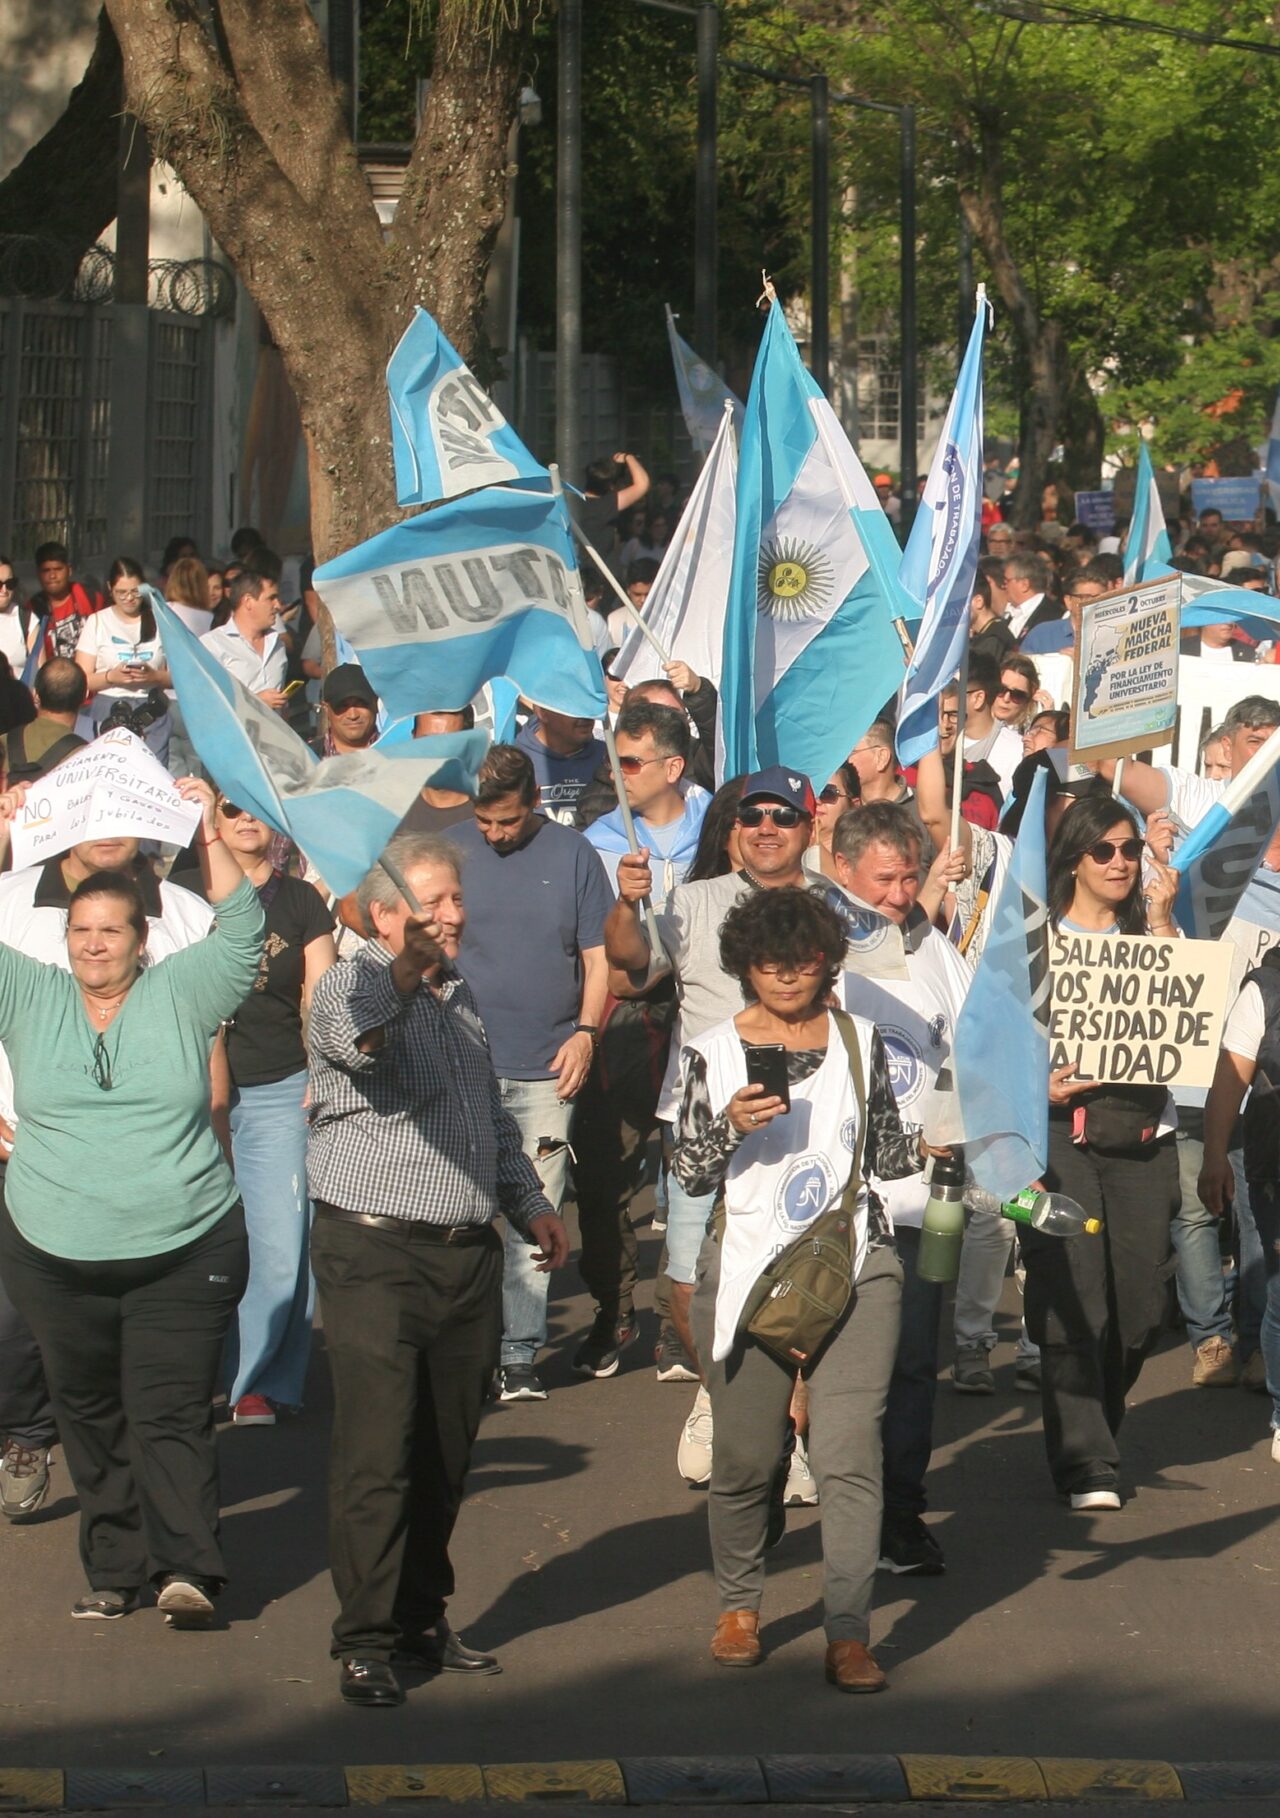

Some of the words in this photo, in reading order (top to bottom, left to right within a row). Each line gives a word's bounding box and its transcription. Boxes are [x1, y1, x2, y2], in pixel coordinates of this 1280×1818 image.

[936, 505, 961, 578] TRABAJADO
[1128, 596, 1139, 615] 2
[1130, 610, 1167, 634] NUEVA
[1124, 623, 1172, 649] MARCHA
[1123, 639, 1171, 662] FEDERAL
[1109, 668, 1174, 691] FINANCIAMIENTO
[1110, 671, 1126, 682] POR
[1127, 668, 1138, 678] LA
[1139, 664, 1153, 675] LEY
[1153, 660, 1164, 671] DE
[1109, 679, 1168, 700] UNIVERSITARIO
[56, 764, 181, 808] UNIVERSITARIO
[24, 798, 52, 824] NO
[33, 831, 57, 847] PARA
[1051, 935, 1174, 972] SALARIOS
[1099, 973, 1140, 1006] NO
[1147, 973, 1205, 1009] HAY
[1174, 1010, 1214, 1046] DE
[1050, 1041, 1182, 1083] ALIDAD
